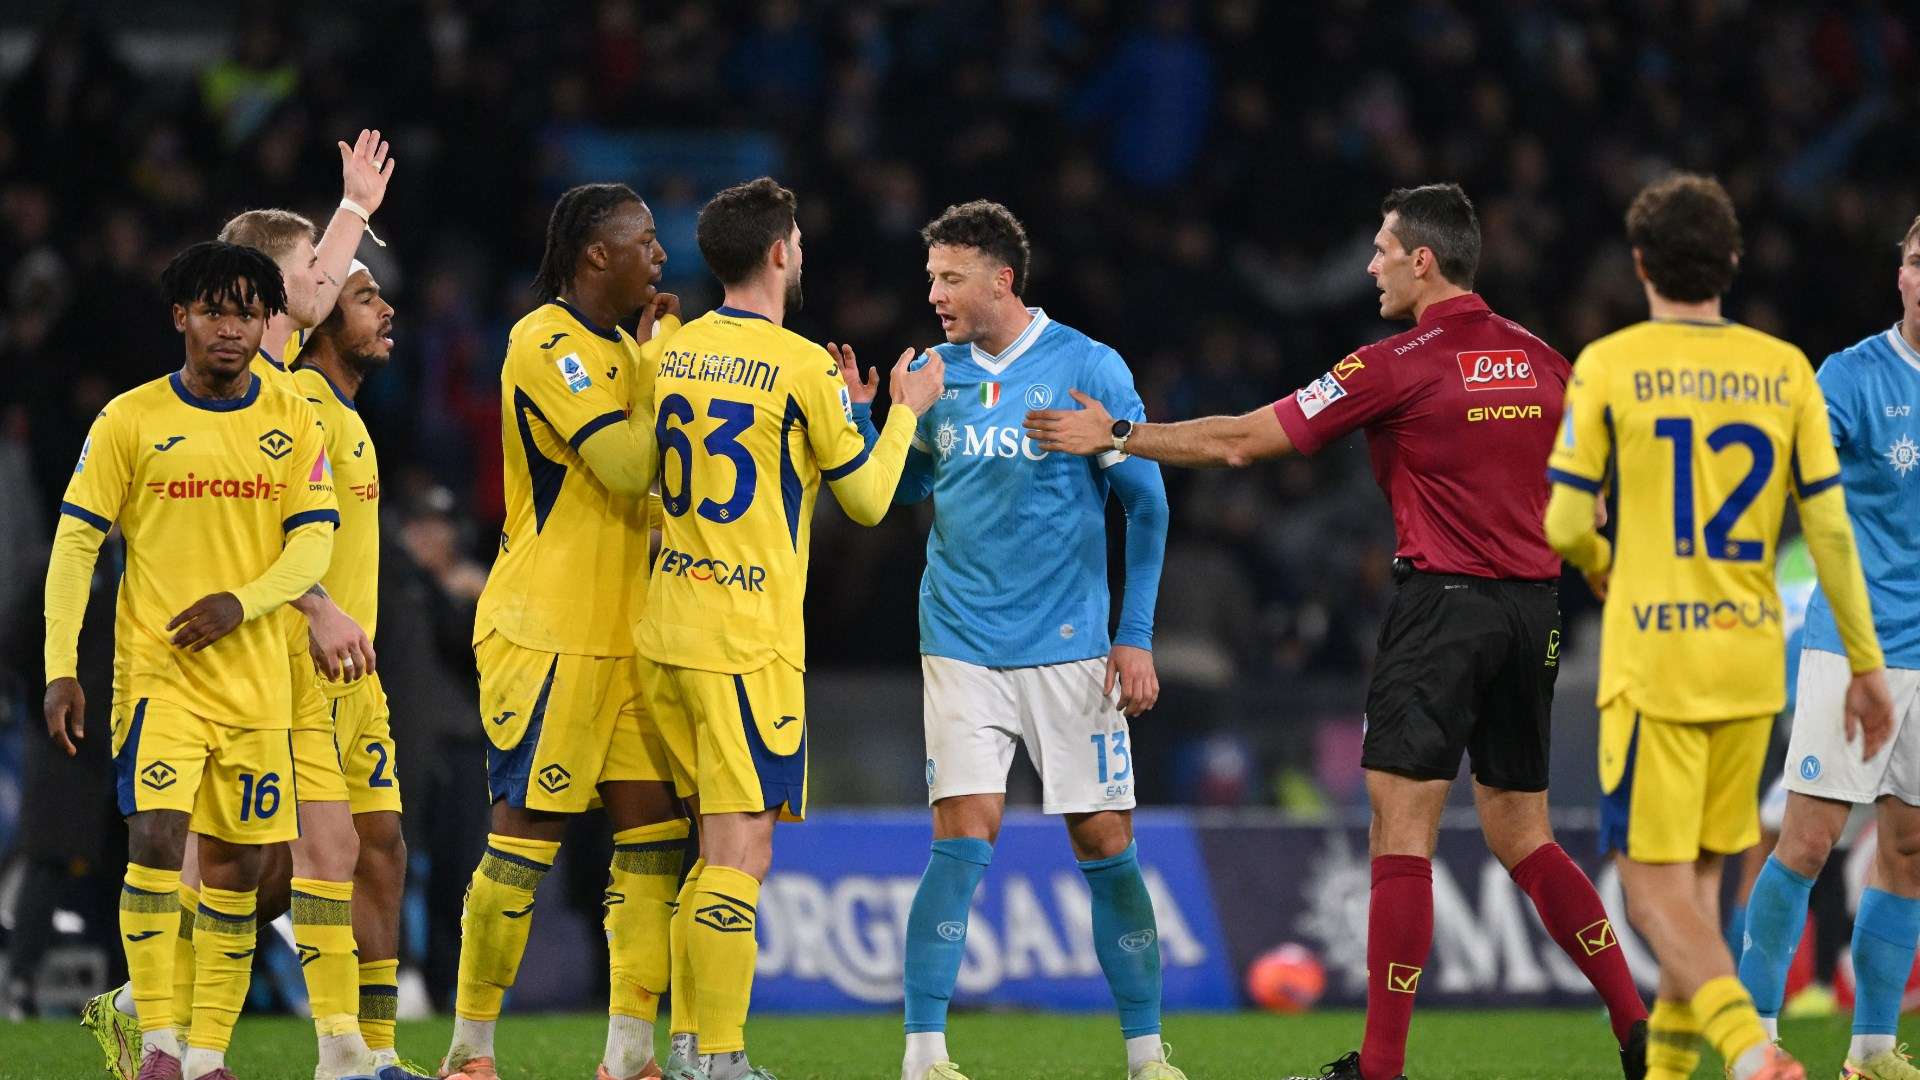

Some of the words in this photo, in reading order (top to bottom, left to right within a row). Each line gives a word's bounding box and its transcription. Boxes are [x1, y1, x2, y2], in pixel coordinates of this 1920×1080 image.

[1394, 340, 1419, 356] DAN
[1416, 327, 1444, 345] JOHN
[1465, 355, 1530, 383] Lete
[1634, 367, 1791, 407] BRADARIĆ
[1467, 405, 1542, 422] GIVOVA
[1885, 406, 1911, 417] EA7
[655, 393, 757, 524] 63
[168, 473, 271, 500] aircash
[1654, 417, 1776, 563] 12
[1090, 730, 1131, 784] 13
[238, 772, 281, 821] 16
[1106, 785, 1129, 797] EA7
